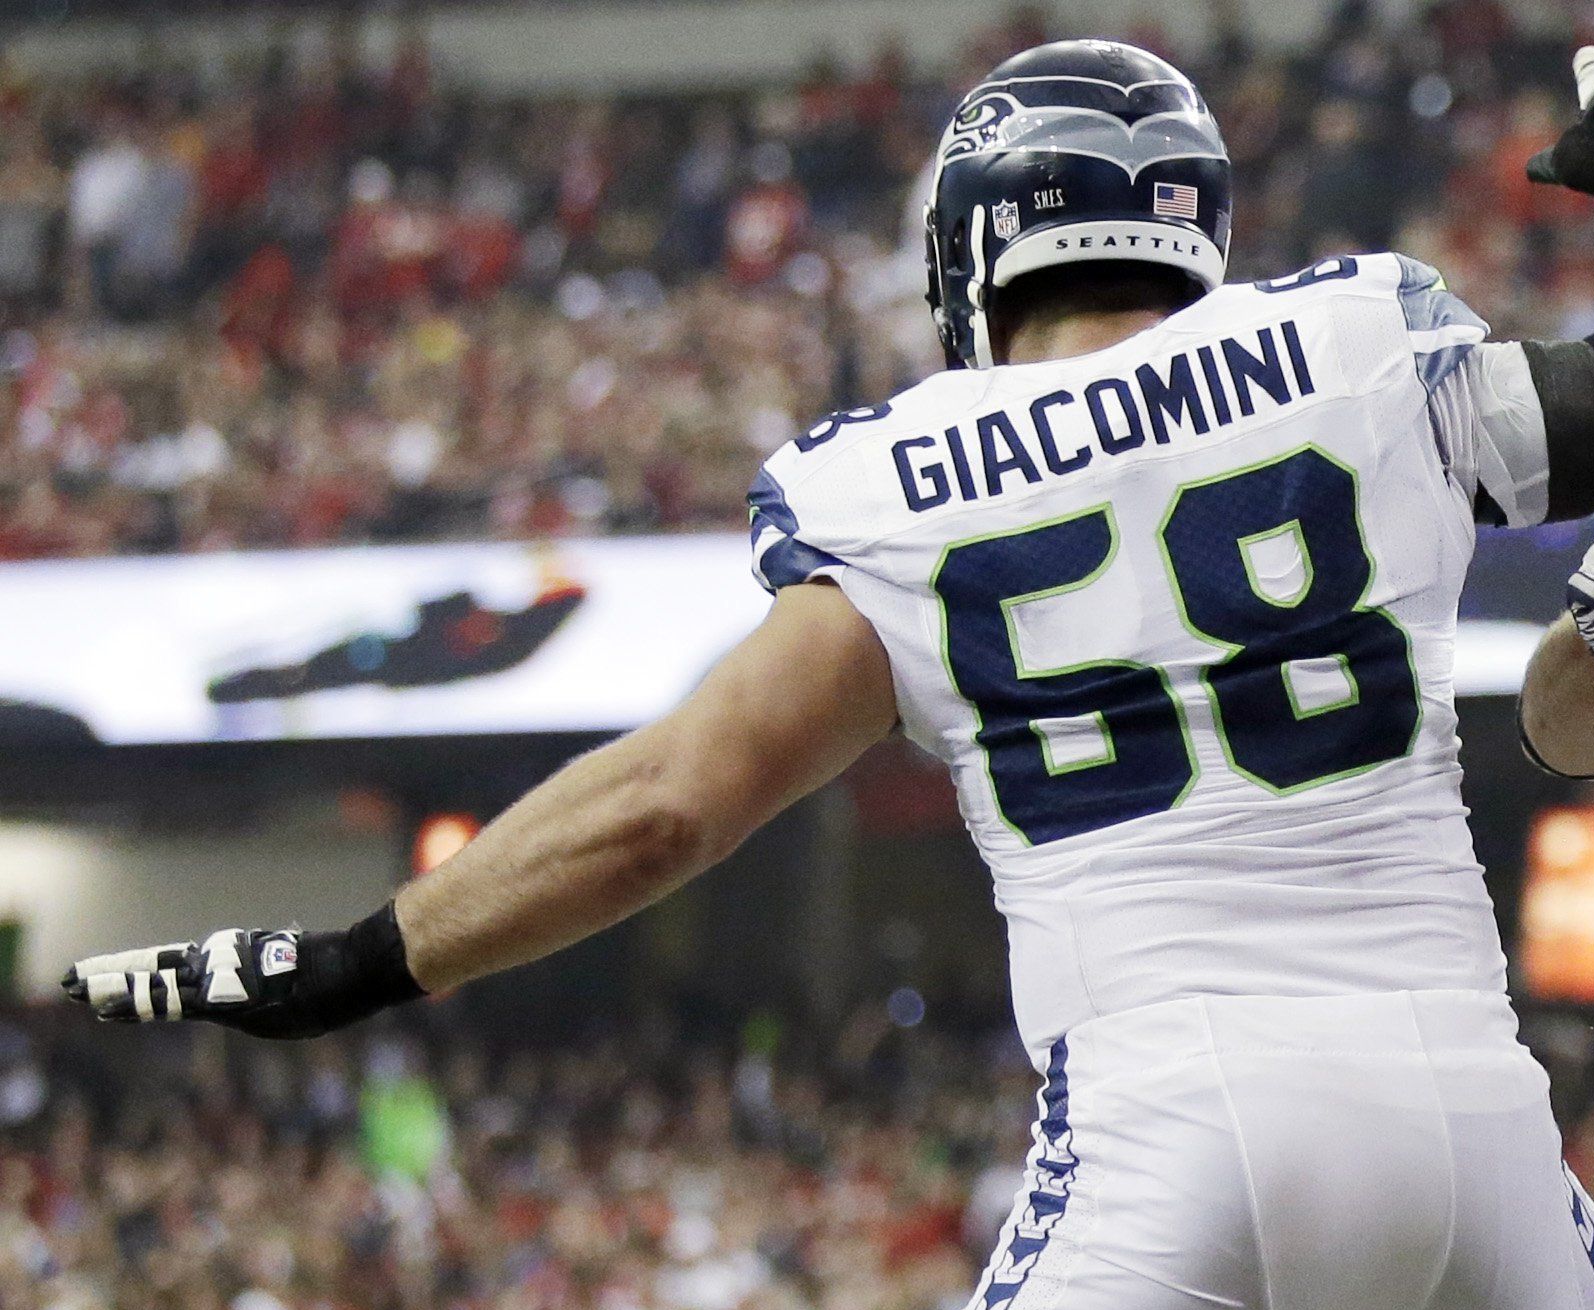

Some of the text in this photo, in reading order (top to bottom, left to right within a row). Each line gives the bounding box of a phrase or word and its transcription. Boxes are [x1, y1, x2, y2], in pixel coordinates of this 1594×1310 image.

[998, 216, 1017, 233] NFL
[1055, 235, 1200, 257] SEATTLE
[891, 321, 1315, 512] GIACOMINI
[929, 441, 1423, 848] 68
